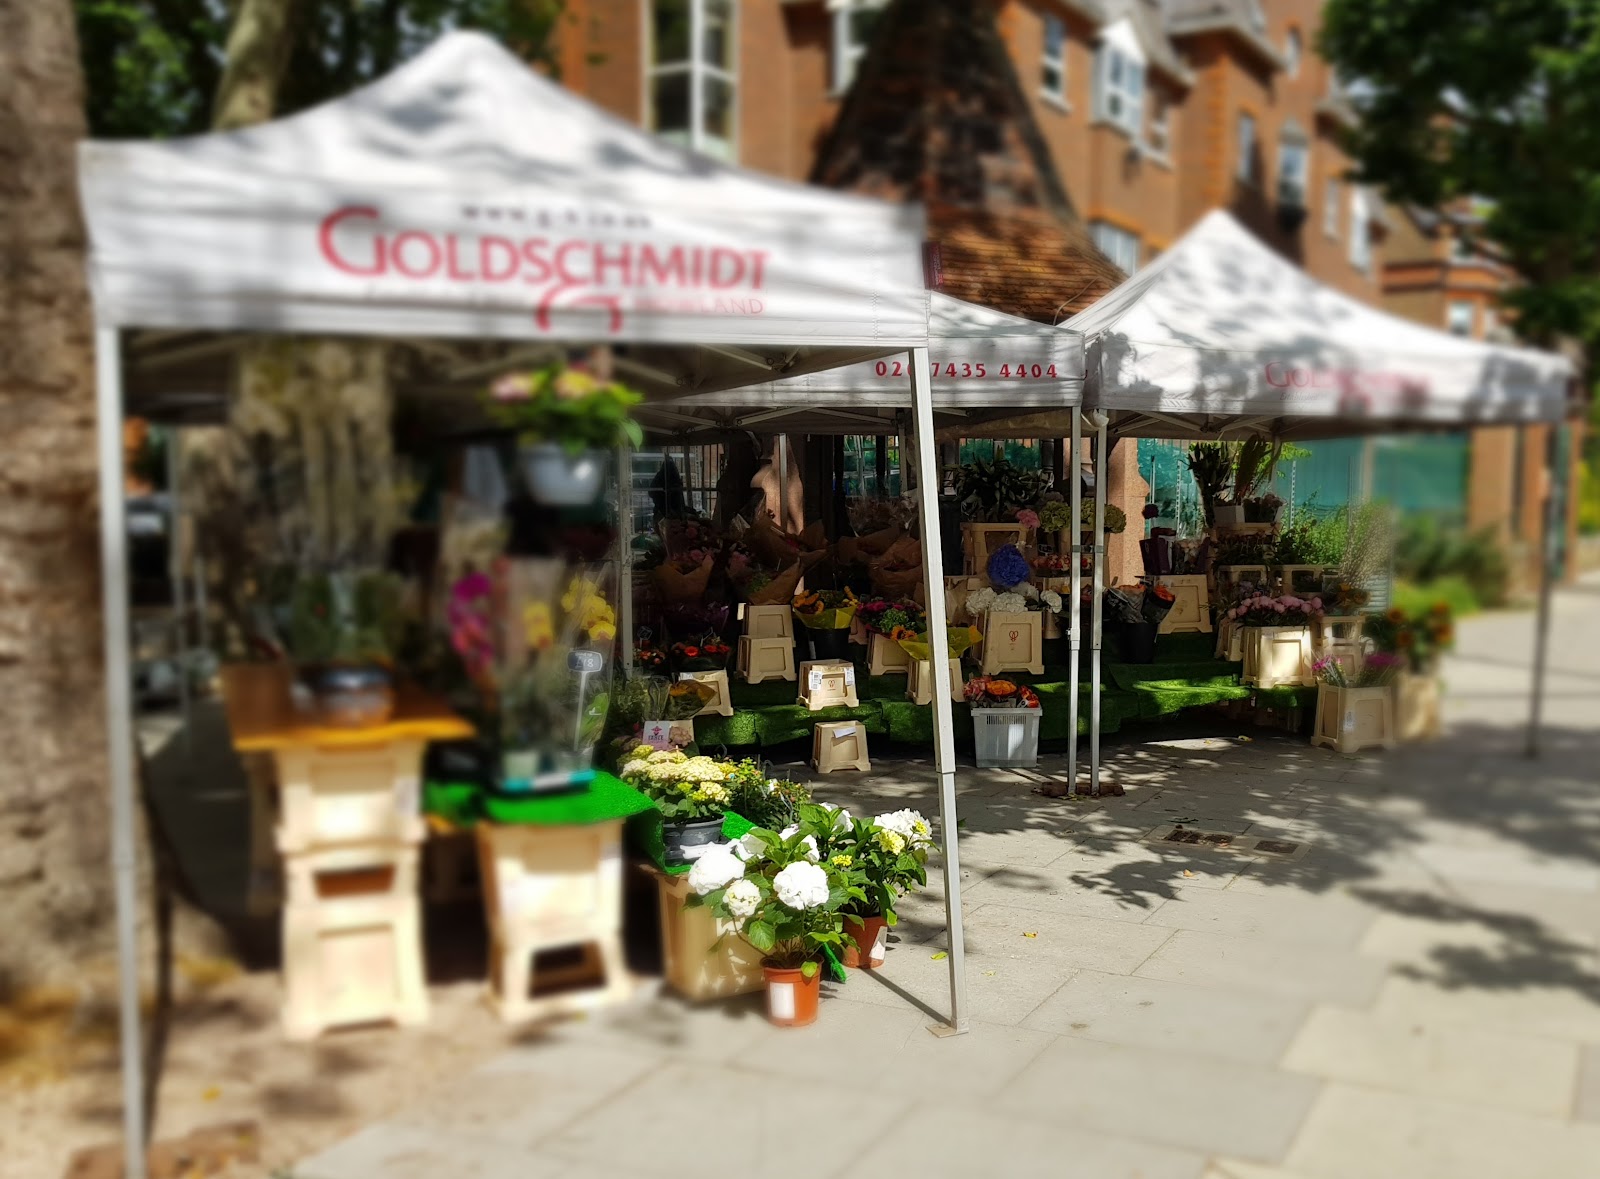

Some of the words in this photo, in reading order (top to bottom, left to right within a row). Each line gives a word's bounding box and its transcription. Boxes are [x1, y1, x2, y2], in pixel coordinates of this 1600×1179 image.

[317, 205, 770, 290] GOLDSCHMIDT
[875, 360, 911, 377] 02
[931, 363, 987, 378] 7435
[999, 363, 1057, 378] 4404
